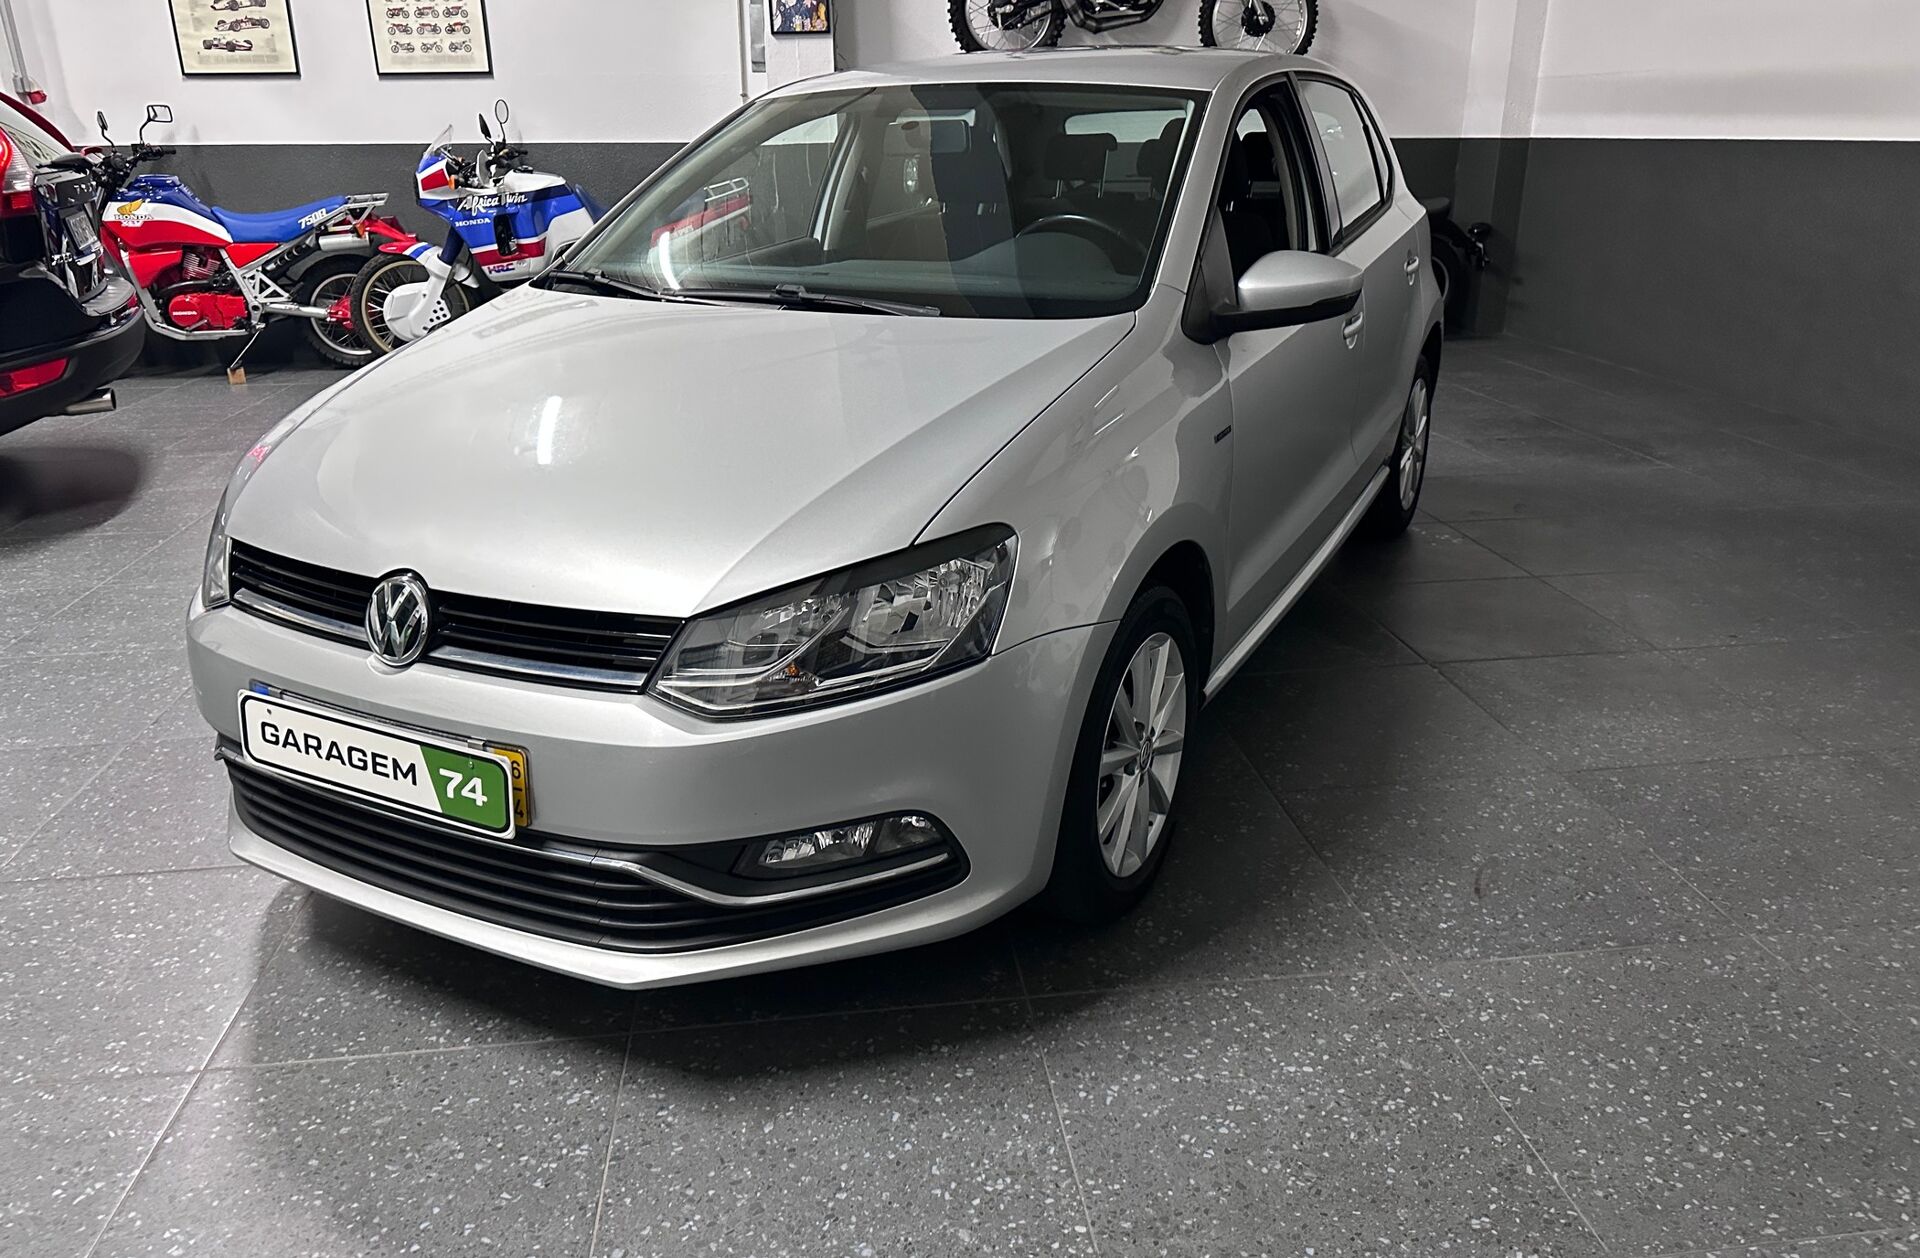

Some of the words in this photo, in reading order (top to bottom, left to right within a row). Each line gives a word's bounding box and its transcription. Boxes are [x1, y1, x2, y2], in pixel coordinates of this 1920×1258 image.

[457, 194, 500, 217] Africa
[500, 191, 528, 209] Twin
[454, 217, 491, 227] HONDA
[487, 262, 515, 275] HRC
[260, 720, 418, 787] GARAGEM
[438, 767, 488, 808] 74
